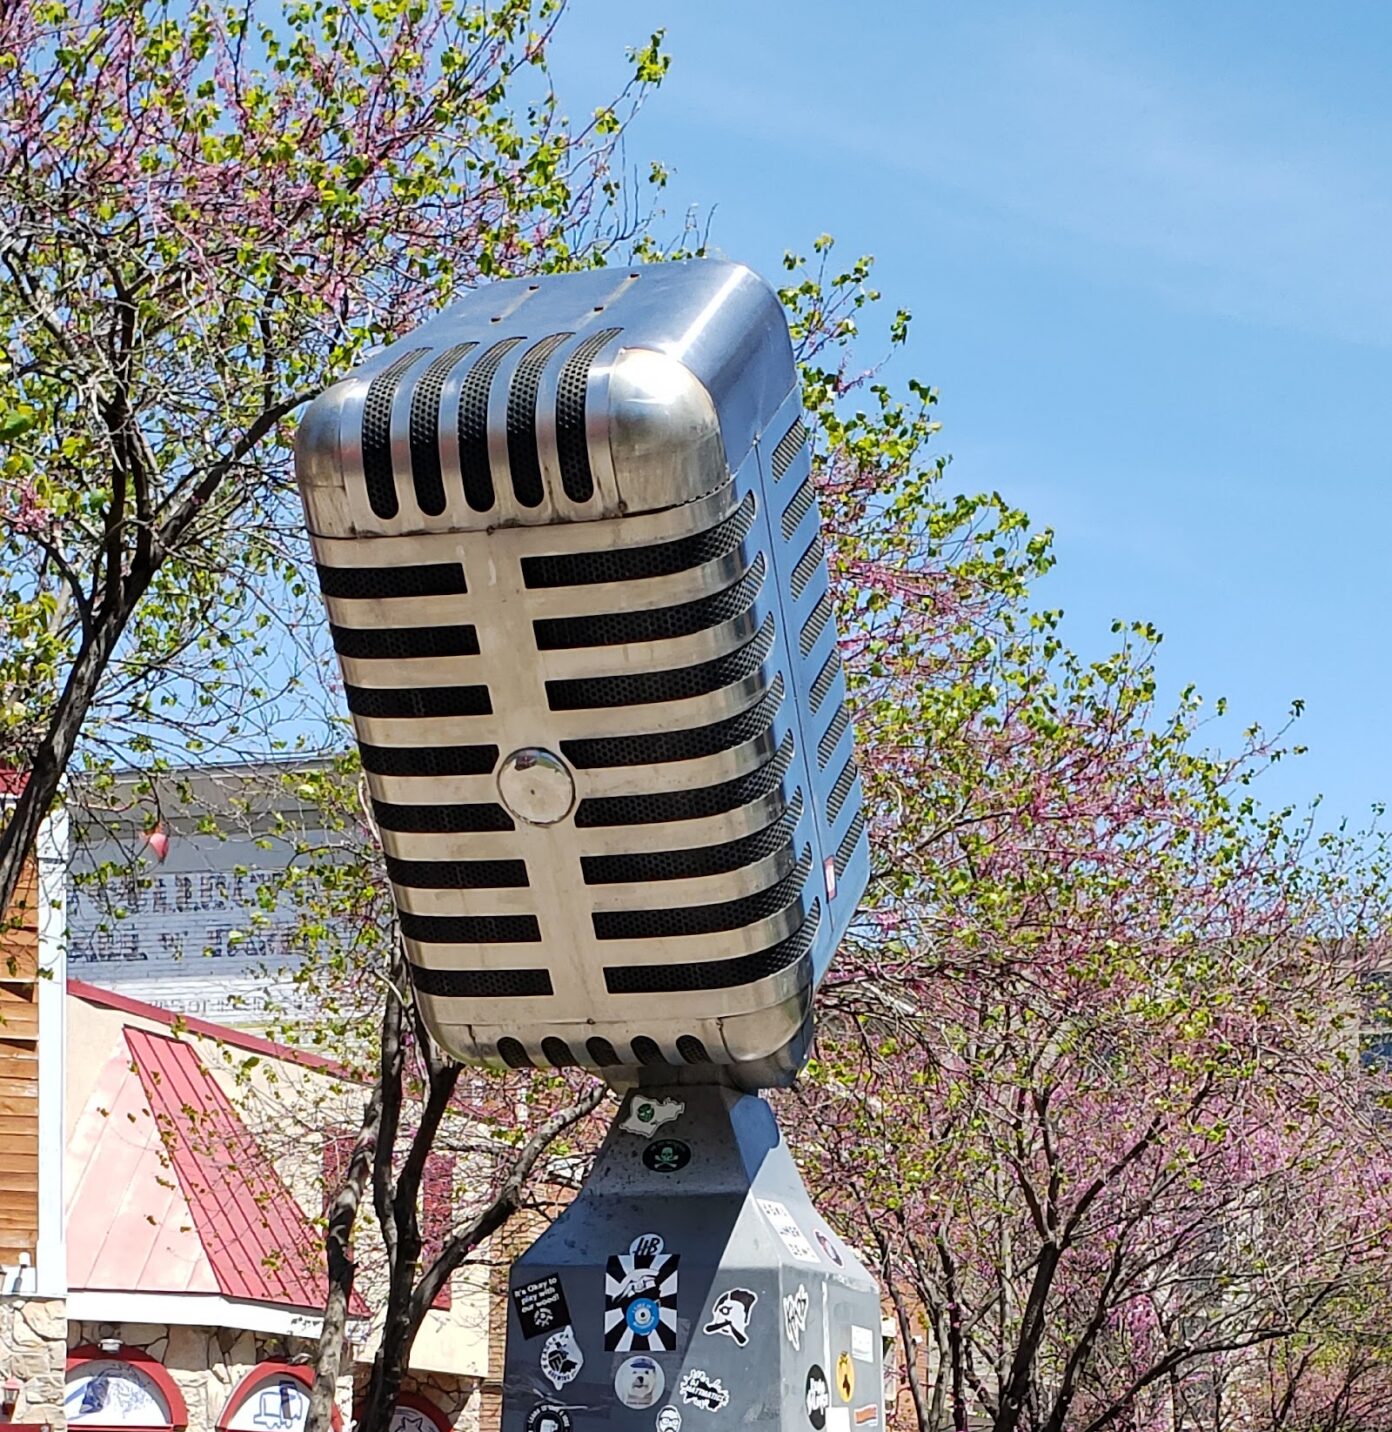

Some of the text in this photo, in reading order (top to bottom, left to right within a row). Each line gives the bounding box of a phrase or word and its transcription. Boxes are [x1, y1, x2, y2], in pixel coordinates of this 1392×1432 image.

[514, 1277, 558, 1298] It's Okay to
[521, 1287, 556, 1305] play with
[521, 1304, 534, 1313] our
